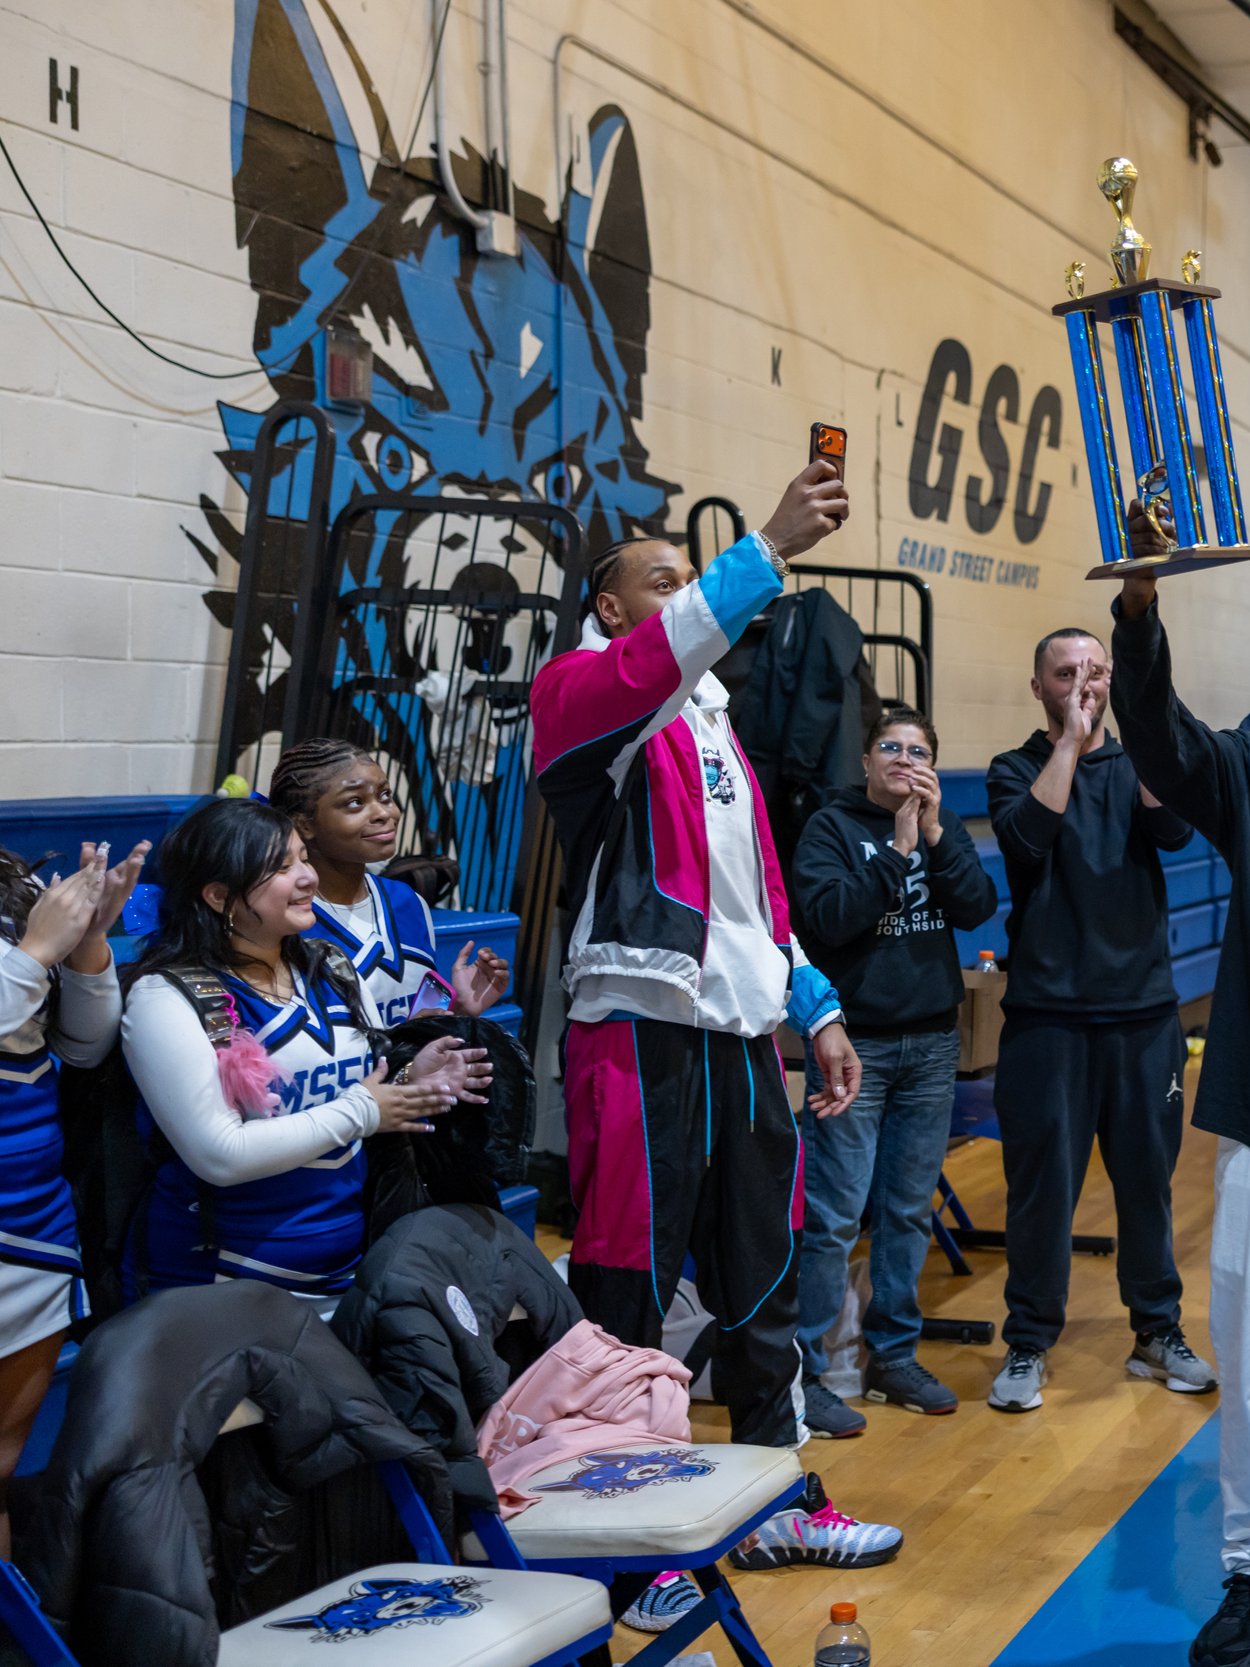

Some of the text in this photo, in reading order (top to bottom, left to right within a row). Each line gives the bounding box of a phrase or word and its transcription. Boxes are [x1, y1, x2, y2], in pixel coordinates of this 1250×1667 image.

[49, 58, 80, 131] H
[771, 346, 782, 387] K
[908, 338, 1062, 546] GSC
[898, 537, 1040, 590] GRAND STREET CAMPUS
[876, 919, 945, 936] SOUTHSID
[912, 911, 929, 921] OF
